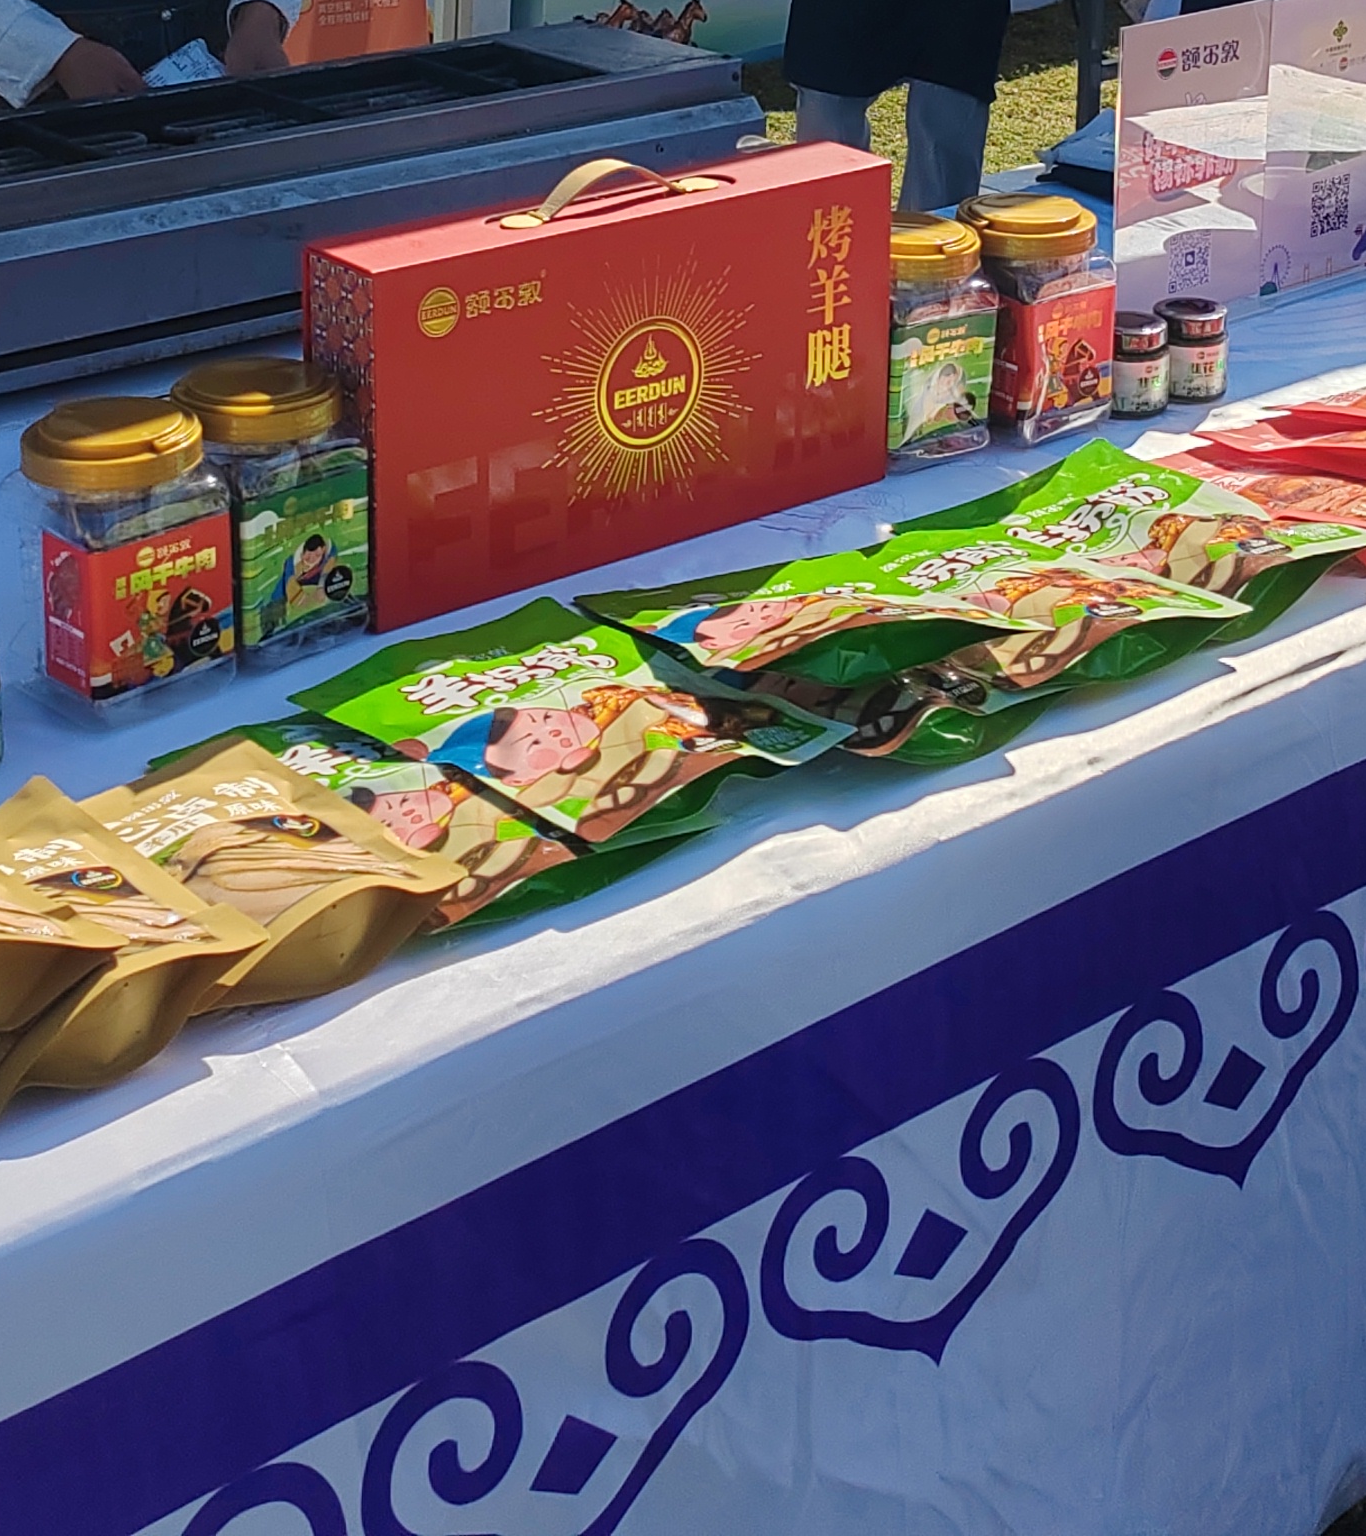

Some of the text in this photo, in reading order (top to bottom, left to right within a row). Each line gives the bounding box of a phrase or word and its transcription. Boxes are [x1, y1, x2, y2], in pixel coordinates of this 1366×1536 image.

[806, 204, 855, 390] 烤羊腿
[420, 303, 458, 322] EERDUN
[613, 373, 687, 411] EERDUN
[223, 798, 284, 817] 原味
